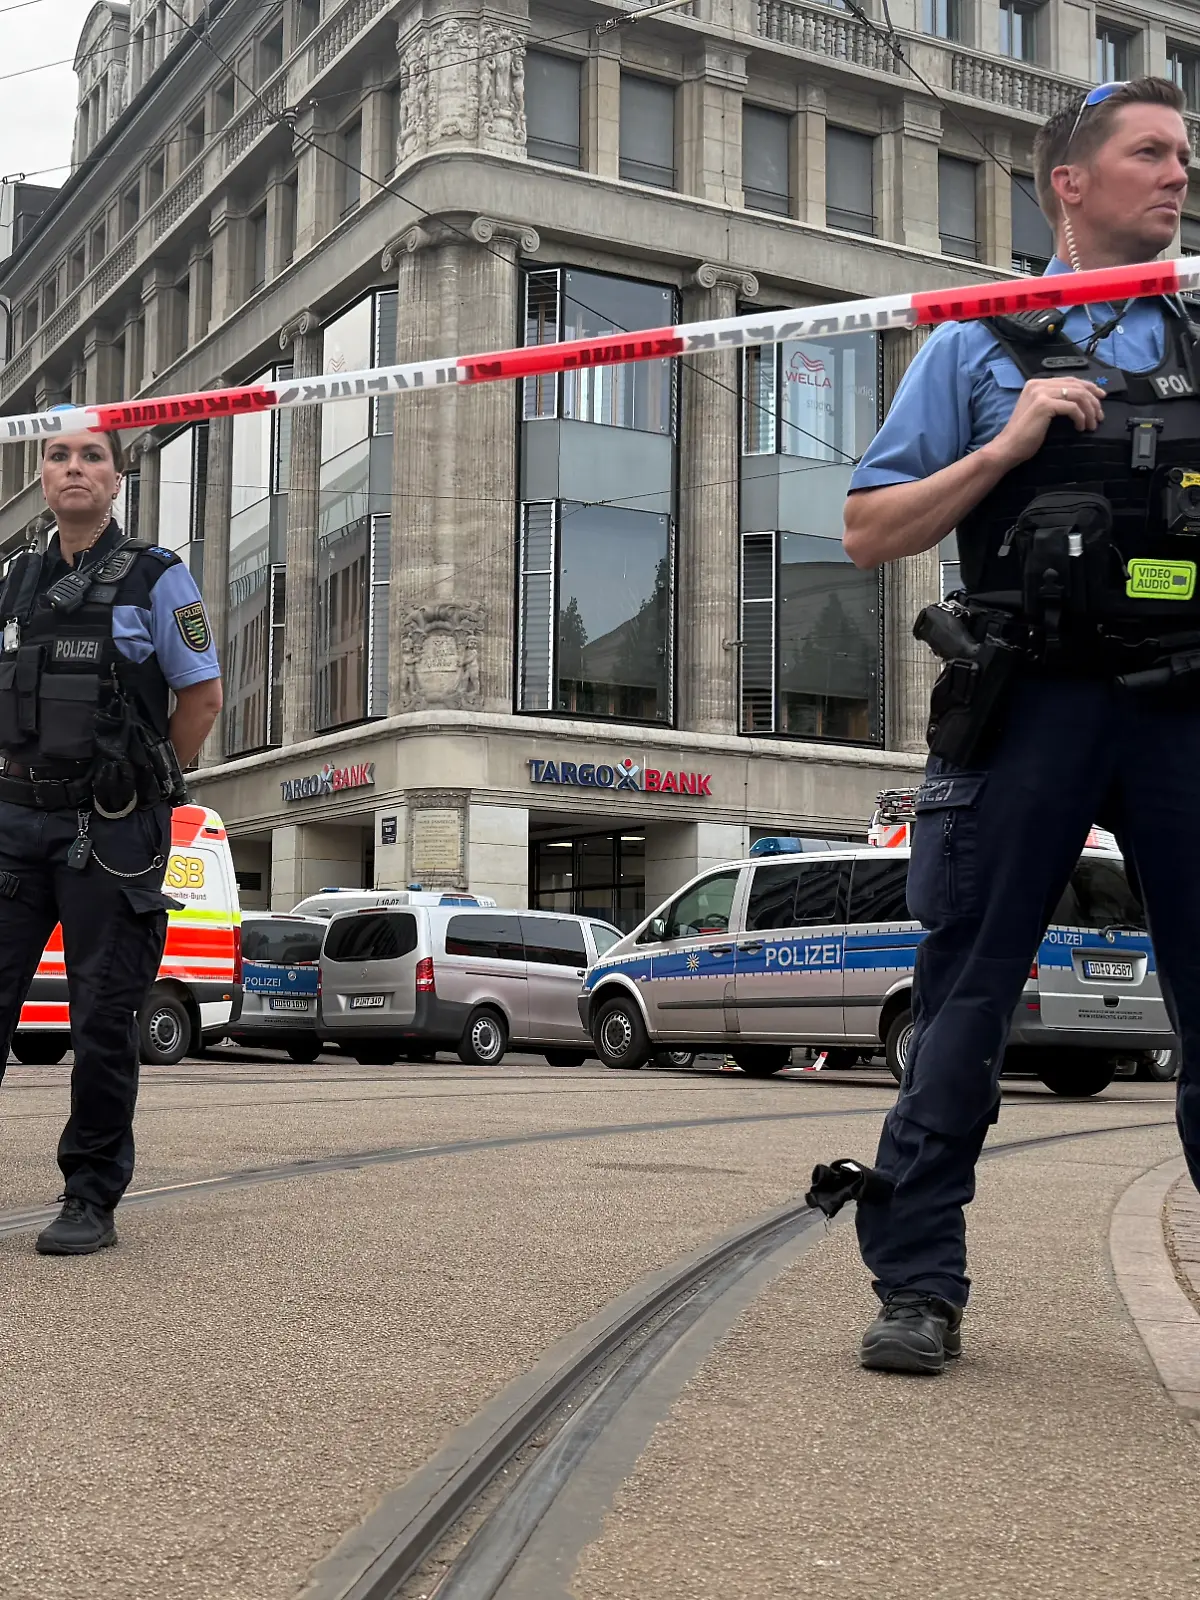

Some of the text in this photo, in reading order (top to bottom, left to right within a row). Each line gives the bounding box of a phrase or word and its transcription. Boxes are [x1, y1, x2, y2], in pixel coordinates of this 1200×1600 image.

[785, 370, 832, 388] WELLA
[1156, 374, 1193, 396] POL
[1138, 567, 1171, 579] VIDEO
[1136, 579, 1171, 590] AUDIO
[55, 640, 99, 659] POLIZEI
[280, 762, 370, 801] TARGO BANK
[527, 758, 713, 796] TARGO BANK
[165, 854, 205, 889] SB
[765, 943, 842, 967] POLIZEI
[1113, 964, 1131, 976] 2587
[244, 976, 282, 987] POLIZEI
